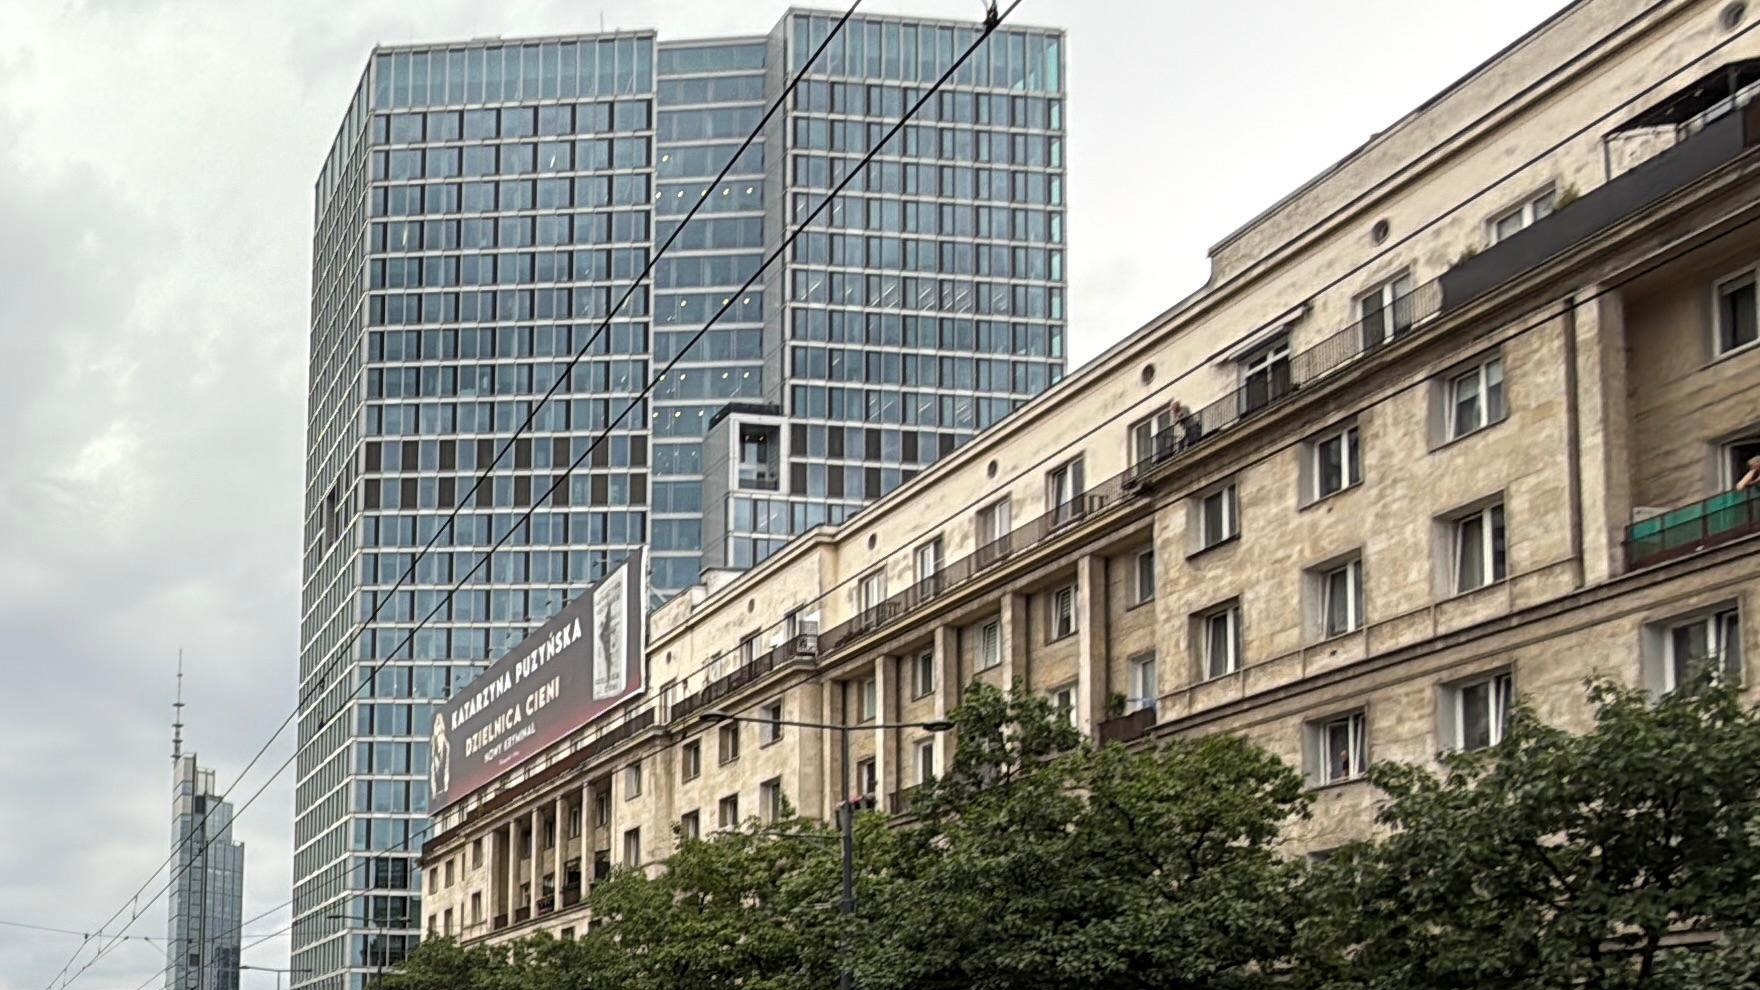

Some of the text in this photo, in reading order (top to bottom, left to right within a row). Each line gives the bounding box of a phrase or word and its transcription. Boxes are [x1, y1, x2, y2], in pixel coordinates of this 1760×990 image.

[451, 617, 582, 732] KATARZYNA PUZYŃSKA
[465, 703, 522, 758] DZIELNICA
[525, 675, 560, 716] CIENI
